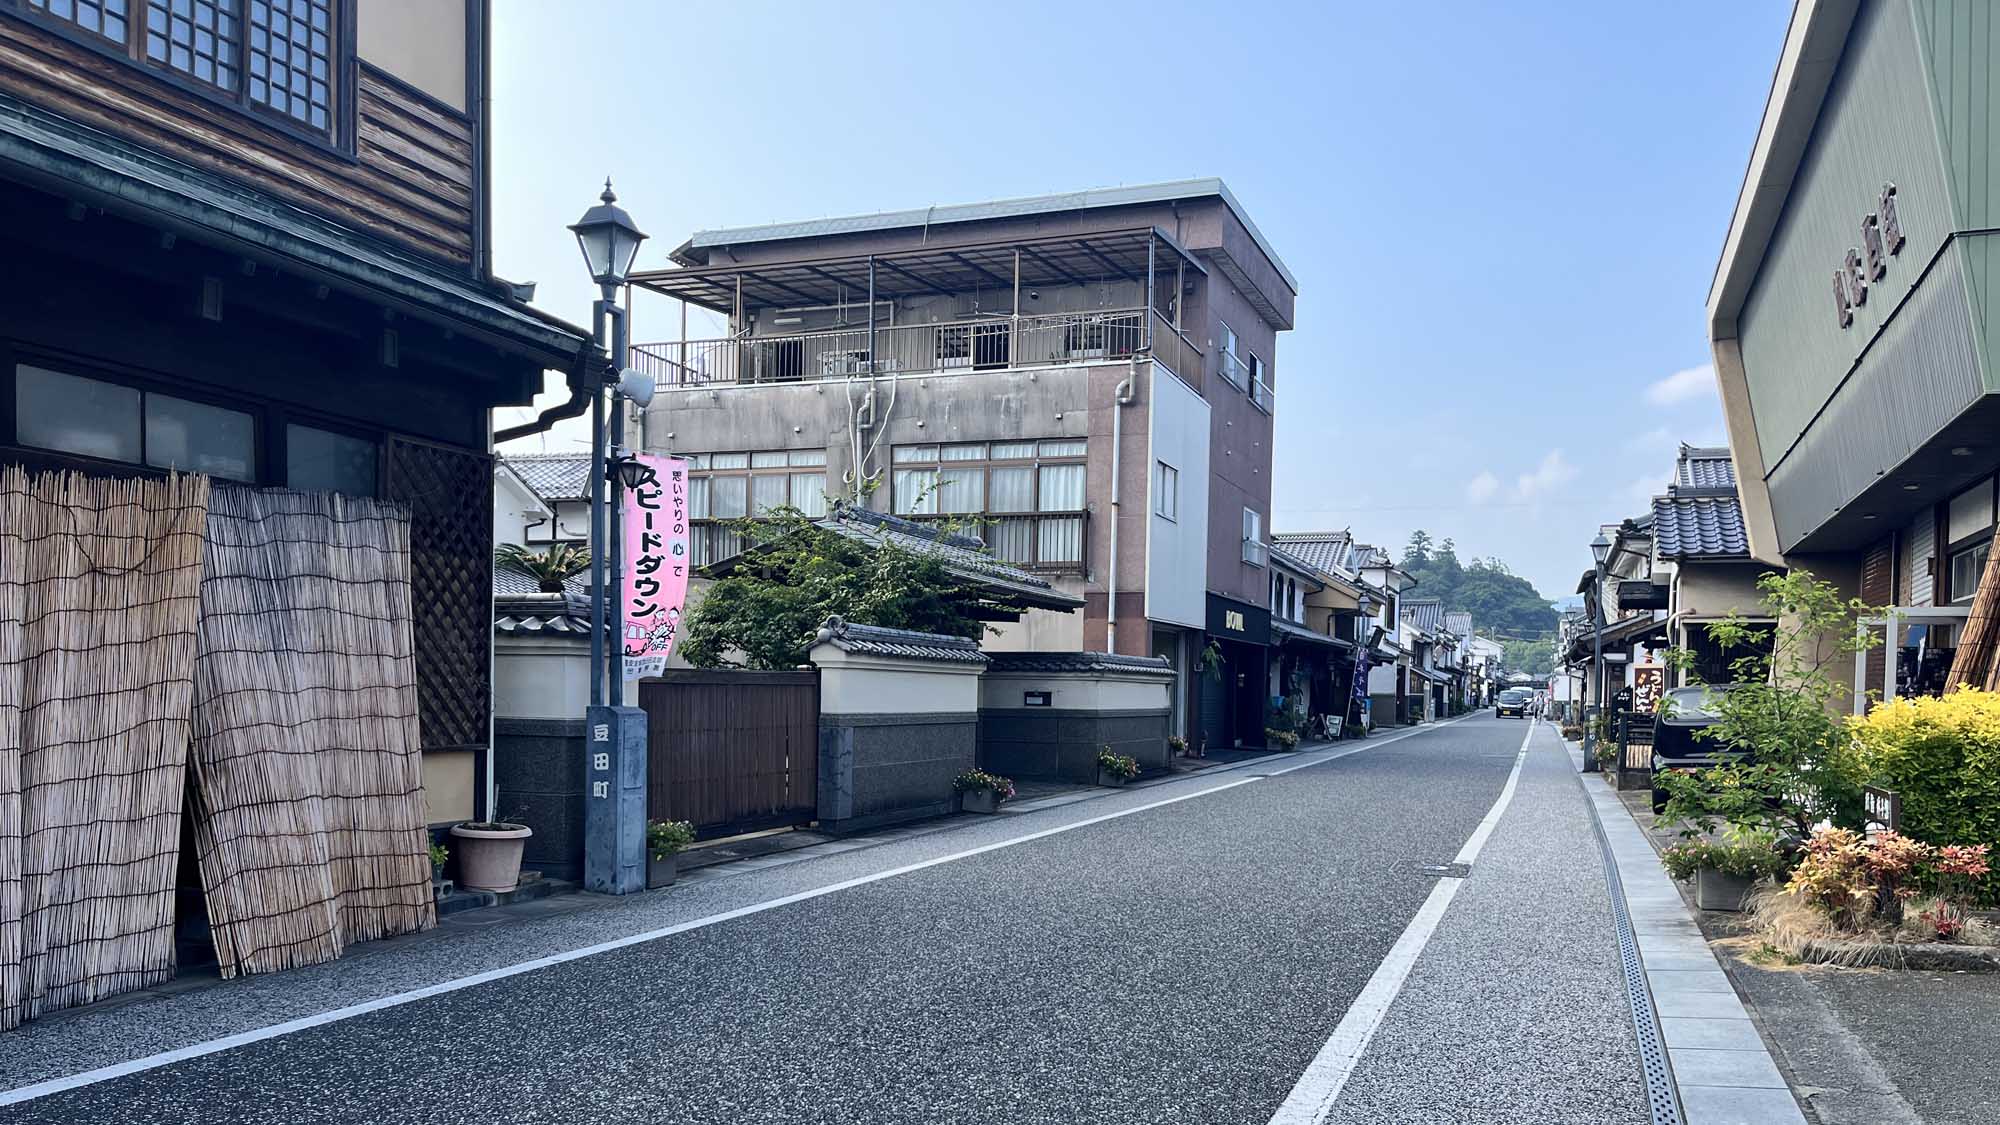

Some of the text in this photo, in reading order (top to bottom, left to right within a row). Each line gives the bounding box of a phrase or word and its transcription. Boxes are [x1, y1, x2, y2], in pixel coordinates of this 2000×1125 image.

[631, 468, 666, 618] スピードダウン
[672, 470, 685, 577] 思いやりの心で
[593, 724, 609, 799] 豆田町
